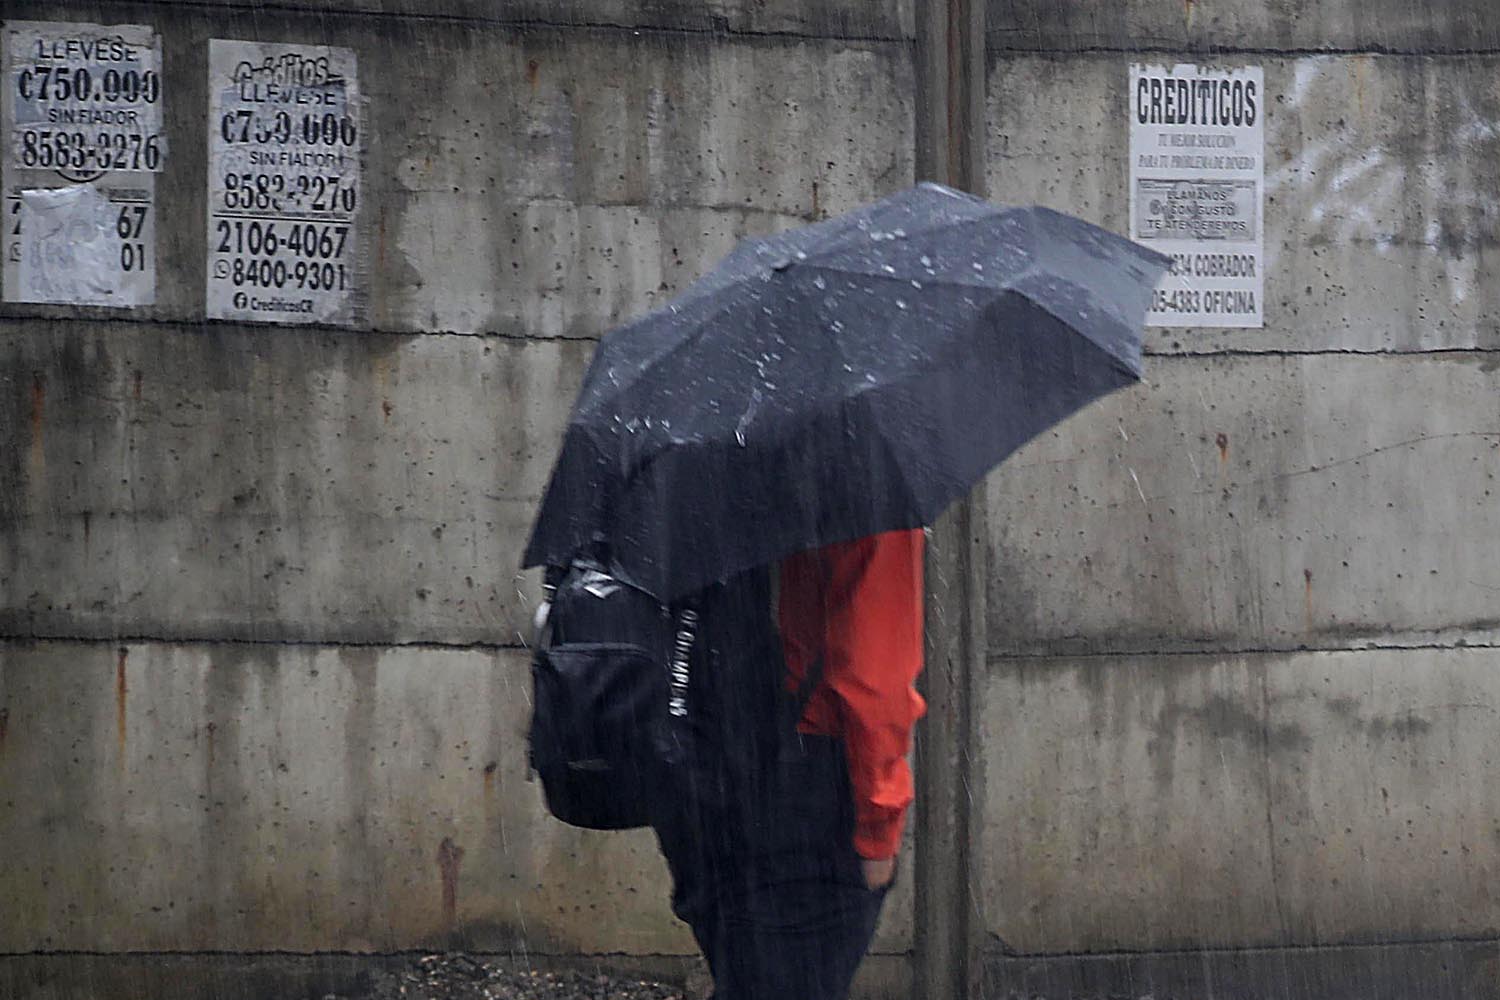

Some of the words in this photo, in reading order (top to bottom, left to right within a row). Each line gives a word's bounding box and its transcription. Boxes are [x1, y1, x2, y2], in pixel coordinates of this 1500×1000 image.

[1137, 77, 1256, 127] CREDITICOS
[49, 108, 75, 123] SIN
[79, 109, 139, 125] FIADOR
[250, 151, 276, 166] SIN
[216, 220, 349, 259] 2106-4067
[232, 257, 345, 291] 8400-9301
[1195, 254, 1256, 278] COBRADOR
[1204, 290, 1257, 314] OFICINA
